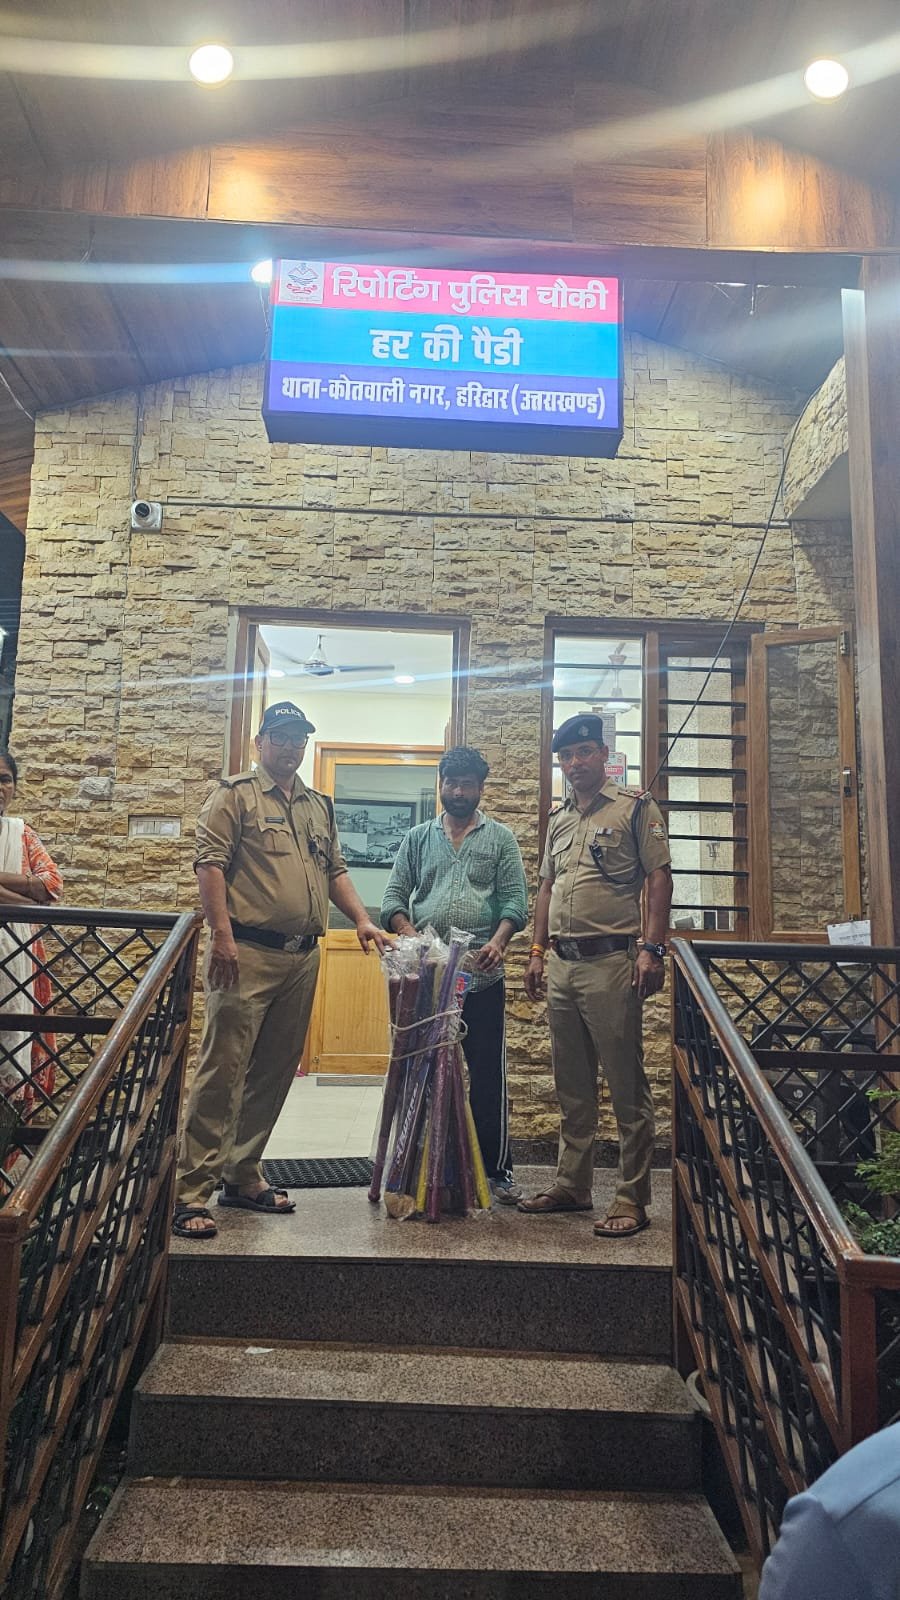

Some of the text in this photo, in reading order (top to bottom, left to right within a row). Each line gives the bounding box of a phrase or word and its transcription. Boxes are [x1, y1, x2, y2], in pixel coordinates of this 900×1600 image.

[449, 276, 528, 312] पुलिस
[537, 279, 608, 310] चौकी
[370, 330, 413, 359] हर
[422, 325, 463, 361] की
[282, 375, 405, 402] थाना-कोतवाली
[410, 384, 450, 409] नगर,
